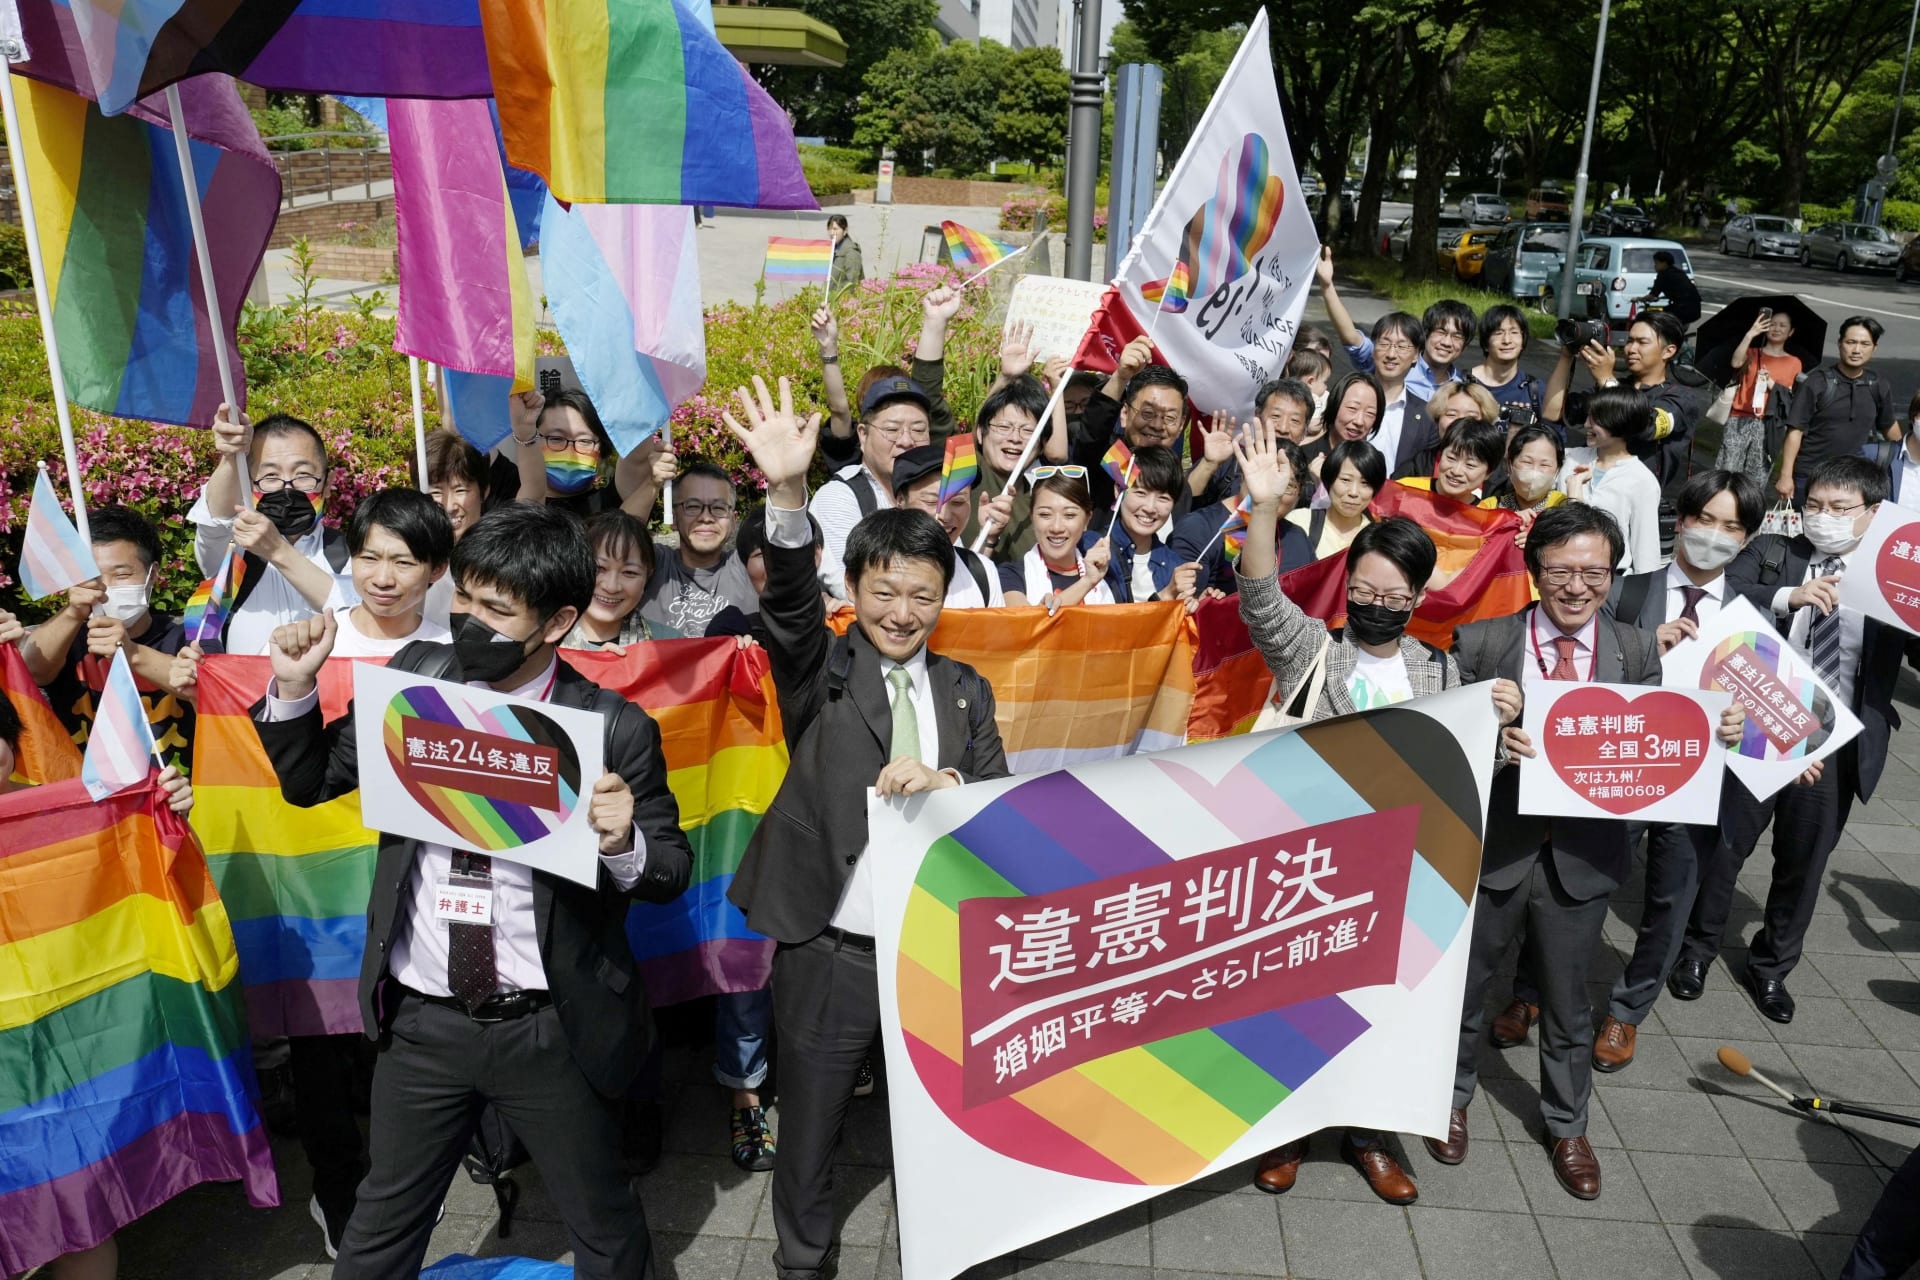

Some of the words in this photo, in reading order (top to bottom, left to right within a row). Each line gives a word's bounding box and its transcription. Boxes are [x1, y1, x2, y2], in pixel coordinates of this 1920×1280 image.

[1717, 673, 1793, 744] 法の下の平等違反
[1728, 653, 1810, 729] 憲法14条違反
[1555, 714, 1645, 737] 違憲判断
[406, 736, 554, 777] 憲法24条違反
[1598, 734, 1700, 760] 全国3例目
[1588, 784, 1666, 799] #福岡0608
[439, 898, 485, 915] 弁護士
[989, 838, 1338, 991] 違憲判決
[993, 911, 1379, 1084] 婚姻平等へさらに前進!
